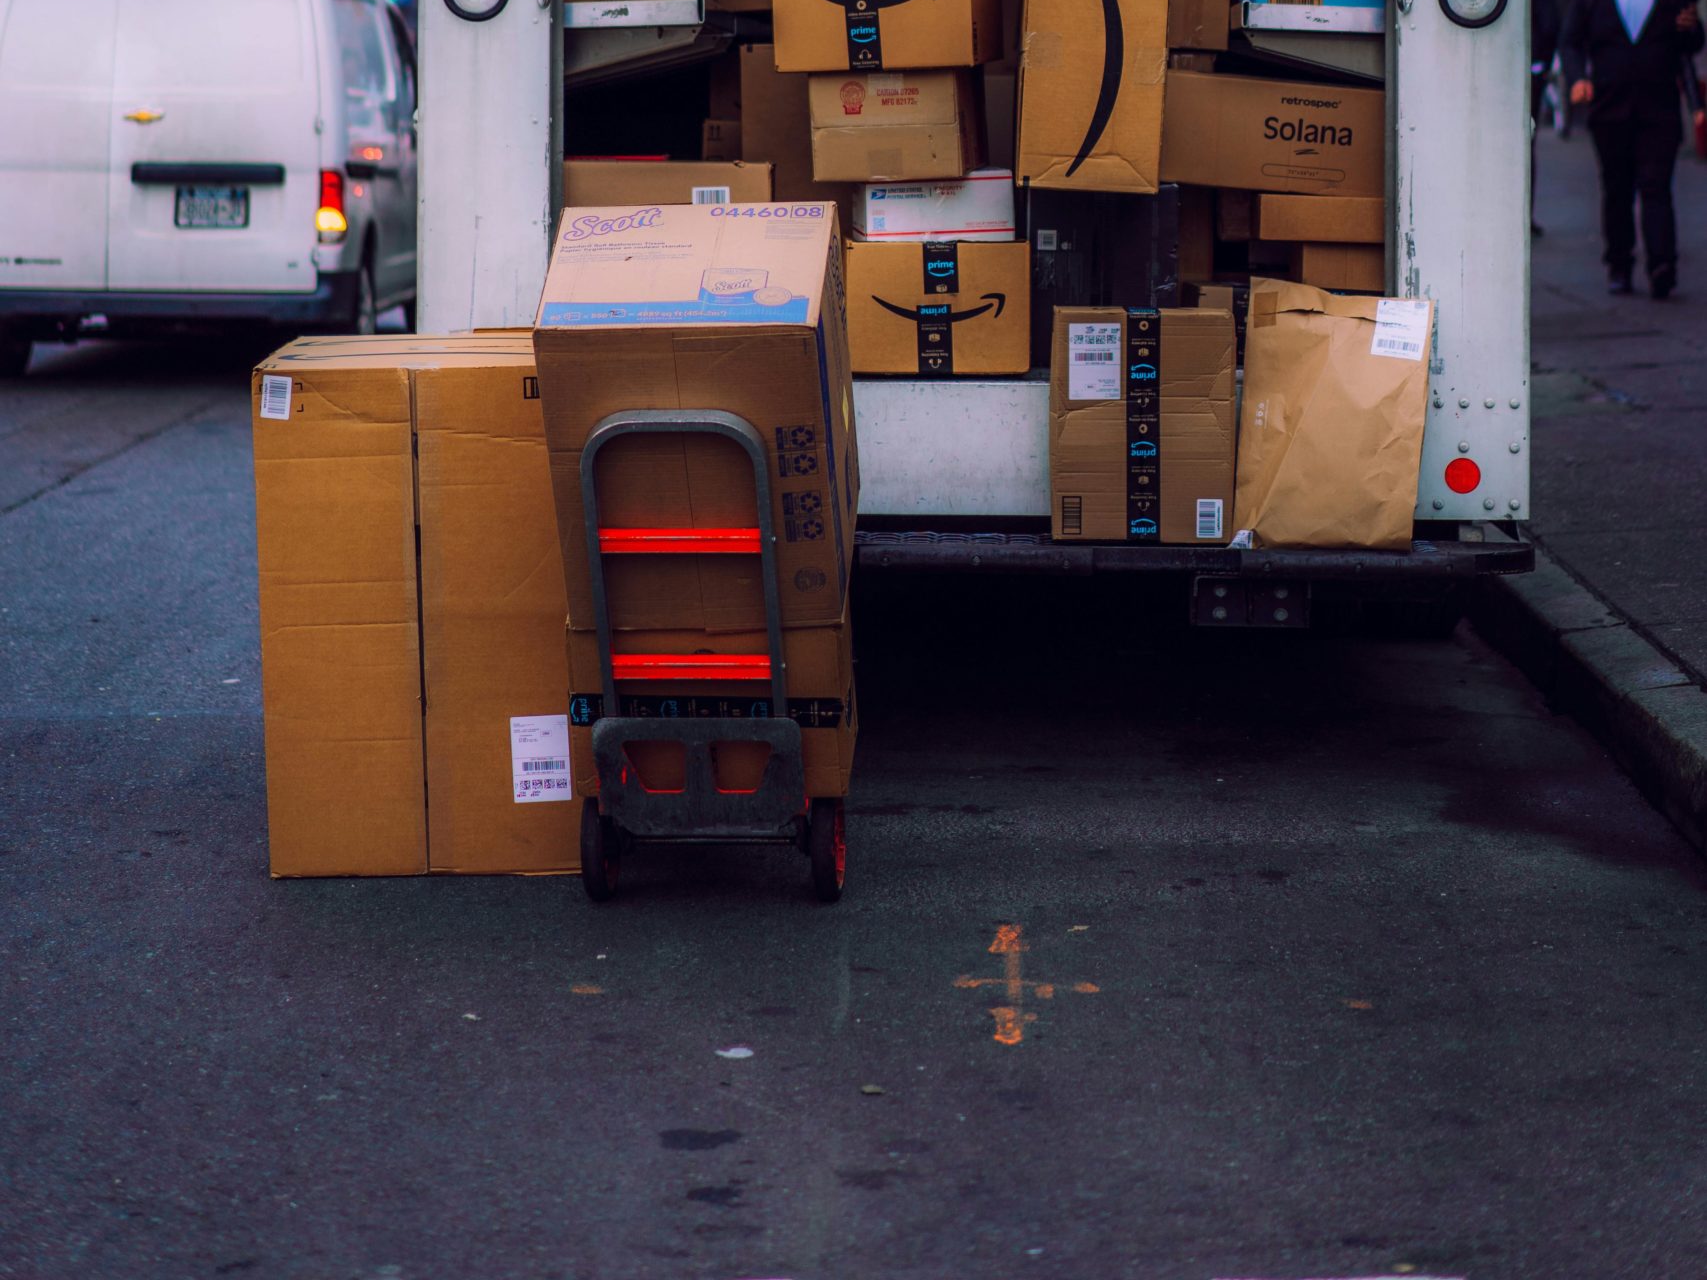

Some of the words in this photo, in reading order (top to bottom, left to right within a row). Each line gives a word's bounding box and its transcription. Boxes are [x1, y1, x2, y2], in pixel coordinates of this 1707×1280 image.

[850, 26, 876, 37] prime
[1281, 96, 1340, 110] retrospec
[1264, 116, 1353, 147] Solana
[710, 207, 789, 219] 04460
[794, 207, 822, 217] 08
[564, 207, 662, 241] Scott
[928, 260, 954, 271] prime
[920, 305, 947, 316] prime
[1131, 371, 1156, 381] prime
[1131, 448, 1156, 458] prime
[1131, 525, 1157, 535] prime
[577, 698, 589, 722] prime
